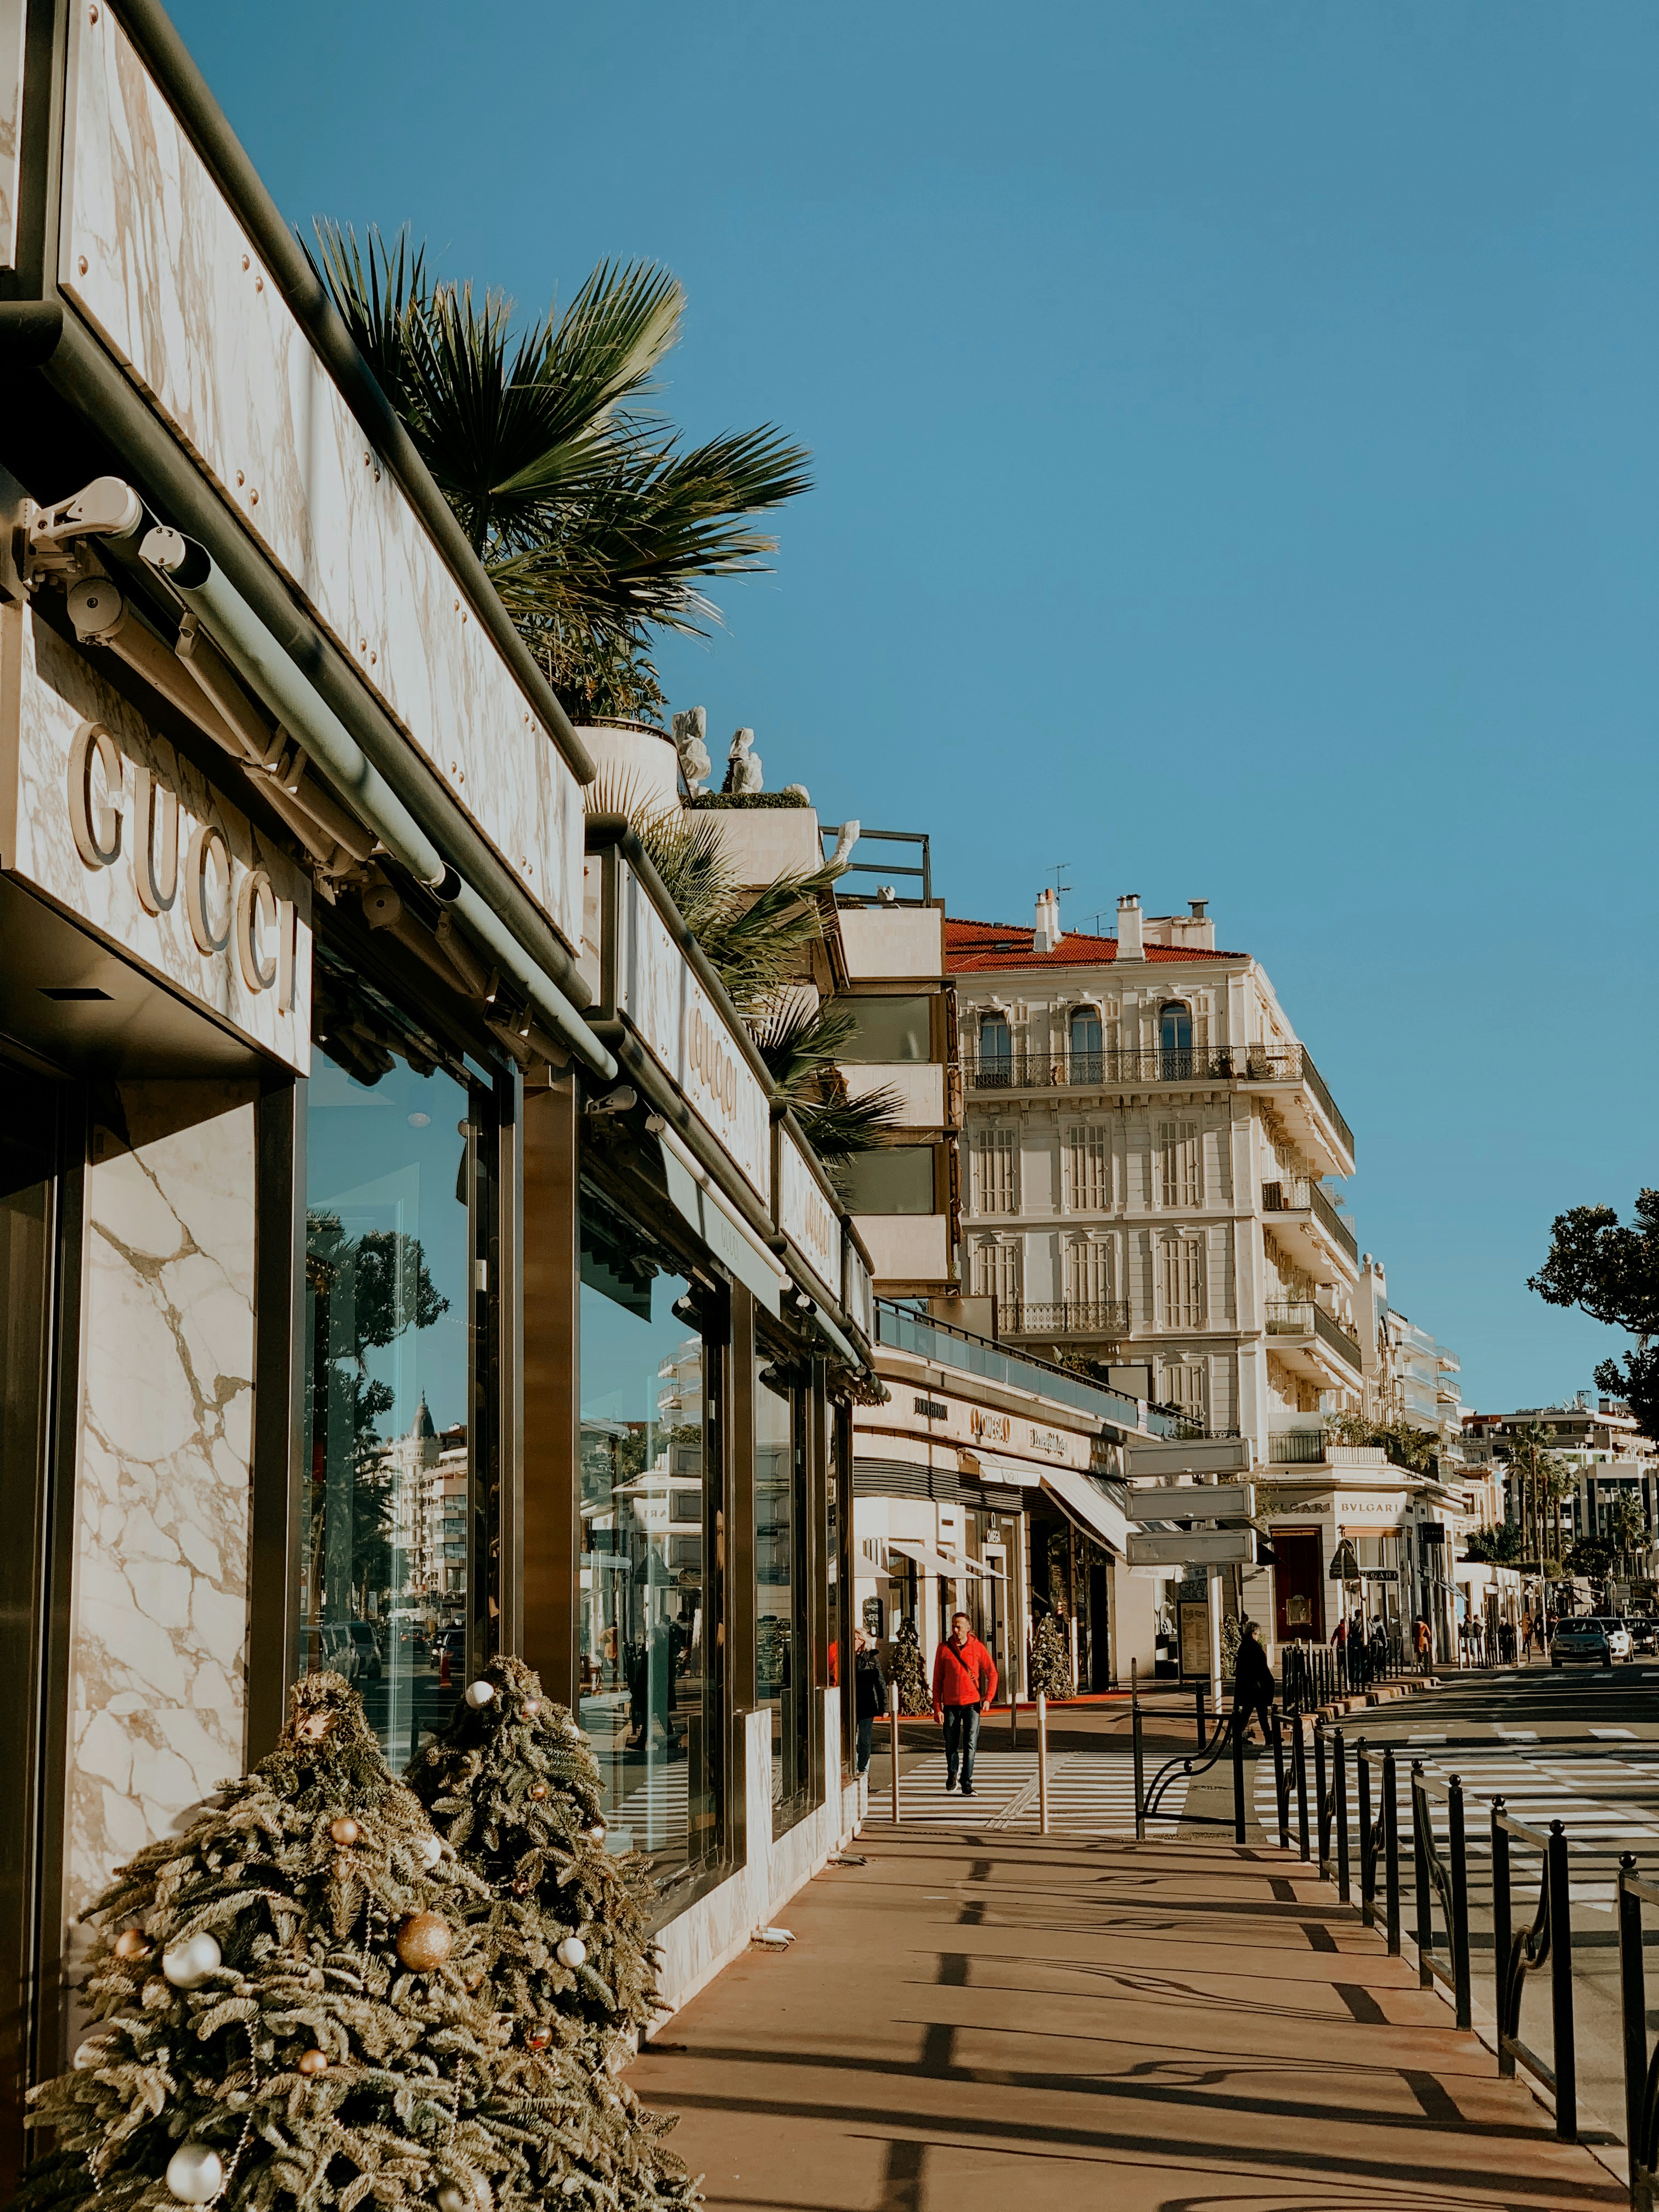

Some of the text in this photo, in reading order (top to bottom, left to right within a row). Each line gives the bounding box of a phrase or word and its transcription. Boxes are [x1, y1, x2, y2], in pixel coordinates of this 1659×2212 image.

[67, 722, 298, 1016] GUCCI
[689, 1007, 737, 1122] GUCCI
[721, 1223, 739, 1263] GUCCI
[805, 1191, 830, 1260] GUCCI
[981, 1414, 1004, 1441] OMEGA
[1341, 1503, 1398, 1512] BVLGARI
